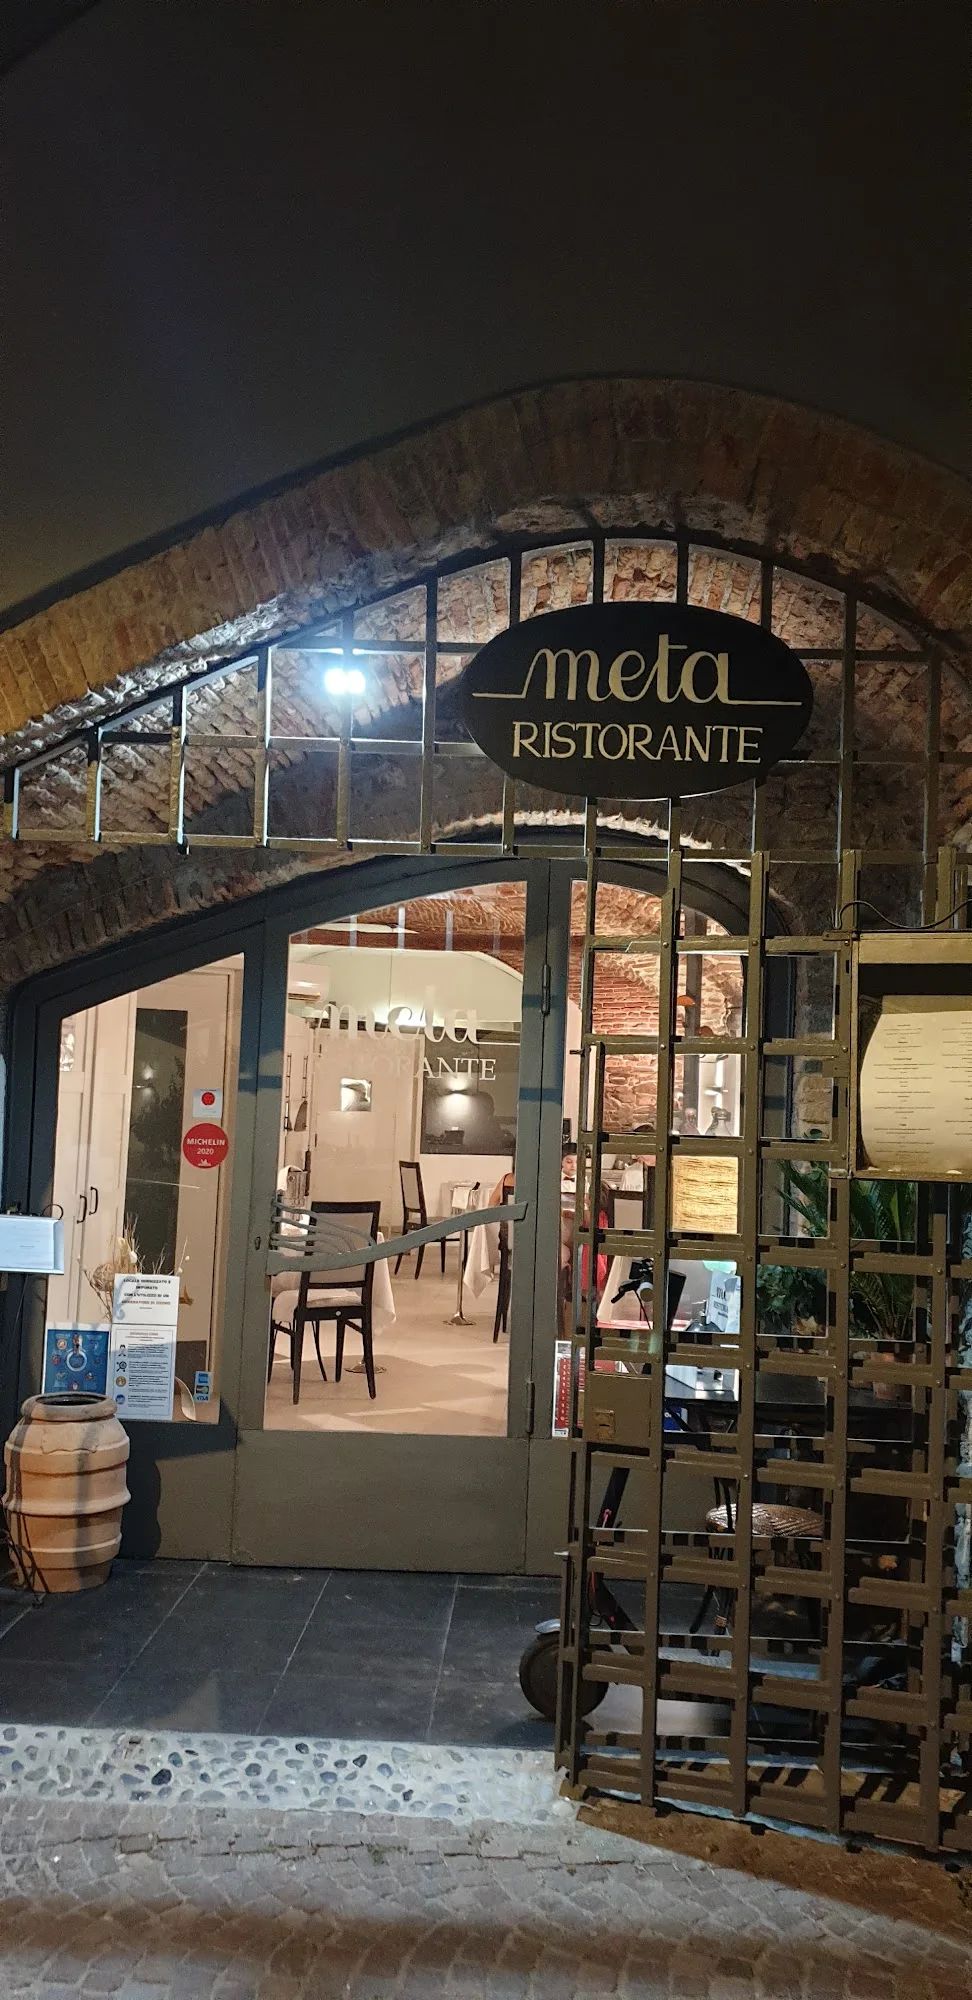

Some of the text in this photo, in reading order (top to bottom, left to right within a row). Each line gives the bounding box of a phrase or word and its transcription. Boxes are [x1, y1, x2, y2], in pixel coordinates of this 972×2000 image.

[472, 633, 803, 707] meta
[512, 721, 763, 763] RISTORANTE
[186, 1138, 226, 1146] MICHELIN
